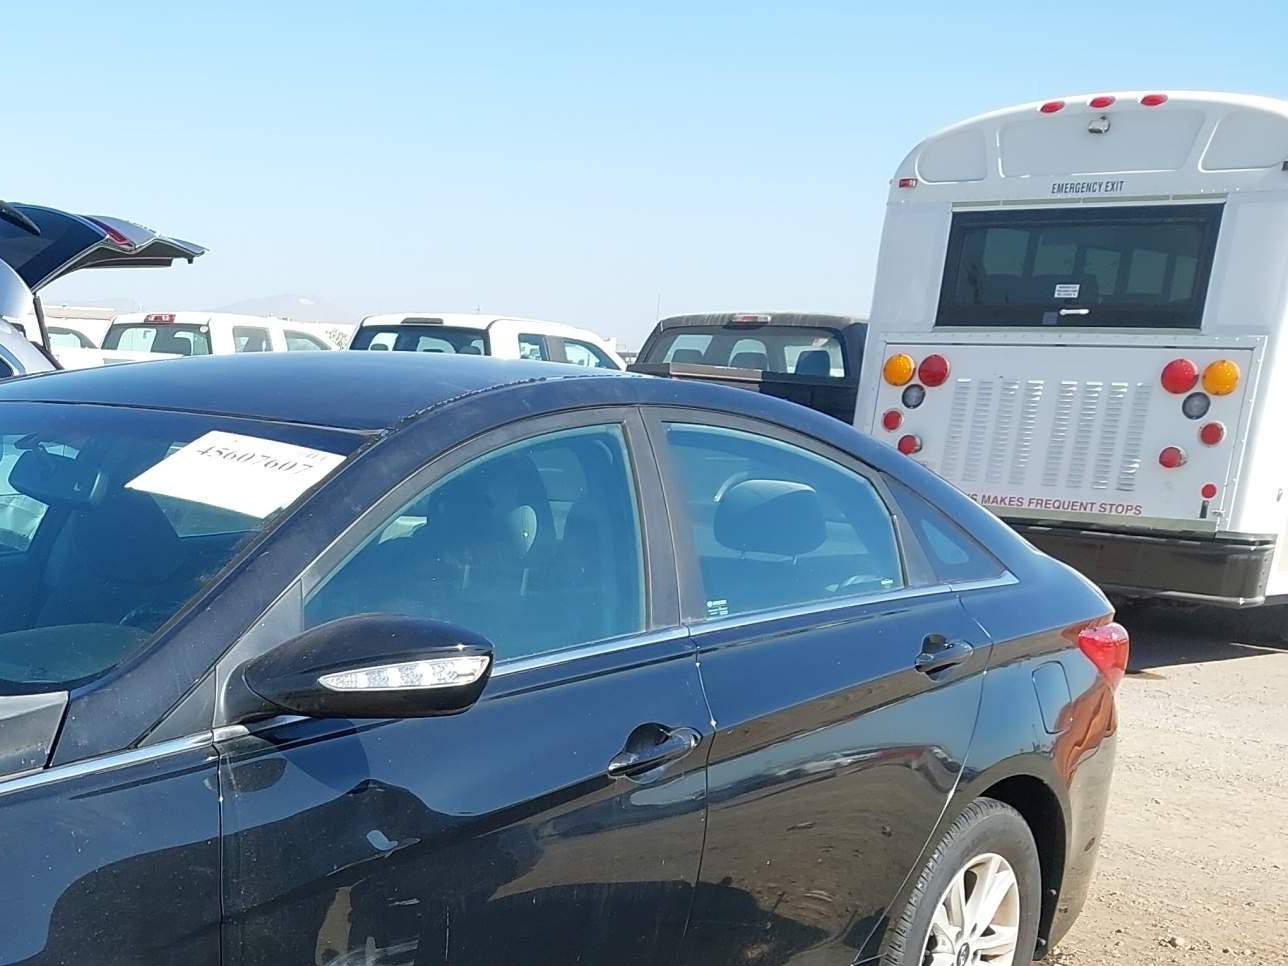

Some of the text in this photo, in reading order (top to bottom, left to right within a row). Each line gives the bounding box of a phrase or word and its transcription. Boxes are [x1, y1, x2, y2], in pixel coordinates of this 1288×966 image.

[1051, 180, 1125, 194] EMERGENCY EXIT
[195, 444, 315, 475] 45607607
[981, 493, 1024, 508] MAKES
[1027, 497, 1096, 513] FREQUENT
[1098, 502, 1143, 515] STOPS
